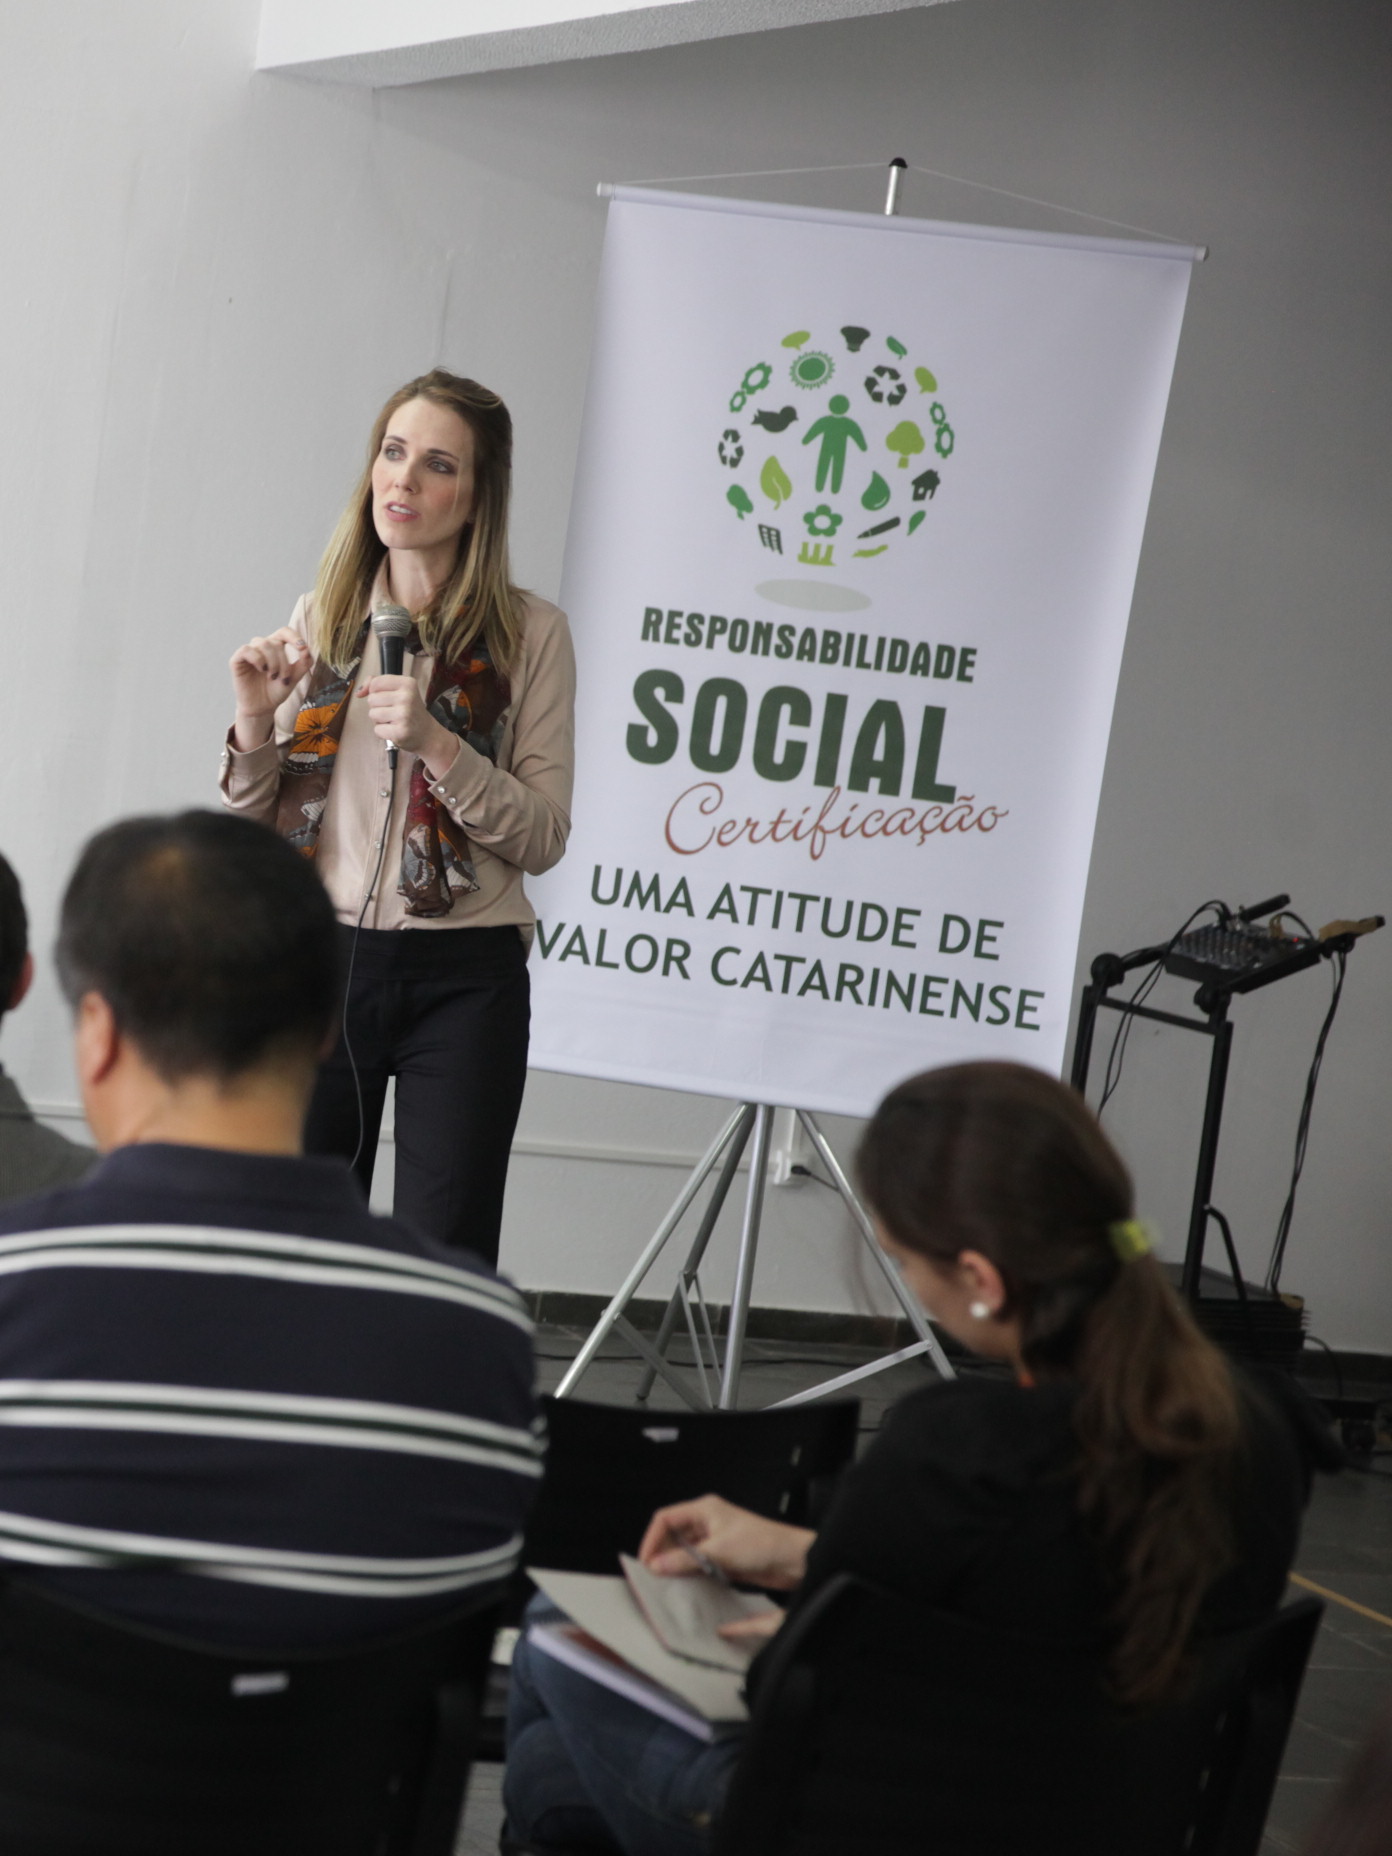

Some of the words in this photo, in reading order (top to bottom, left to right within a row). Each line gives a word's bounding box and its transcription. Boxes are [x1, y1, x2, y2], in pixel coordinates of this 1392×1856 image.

[640, 606, 978, 684] RESPONSABILIDADE
[625, 668, 958, 804] SOCIAL
[664, 782, 1010, 860] Certificação
[590, 864, 695, 918] UMA
[707, 882, 922, 949] ATITUDE
[938, 913, 1005, 960] DE
[536, 919, 691, 980] VALOR
[710, 946, 1046, 1031] CATARINENSE
